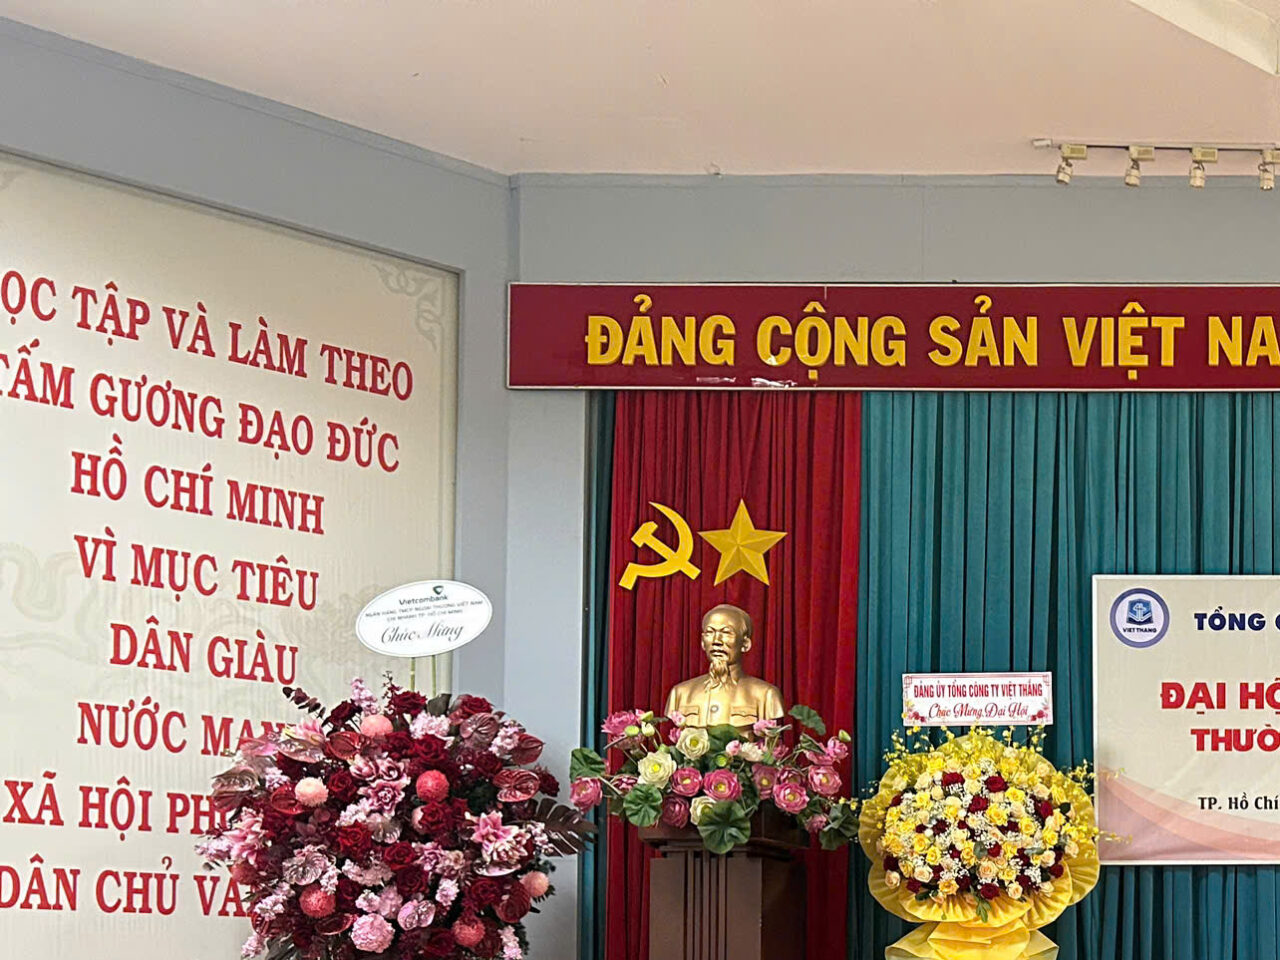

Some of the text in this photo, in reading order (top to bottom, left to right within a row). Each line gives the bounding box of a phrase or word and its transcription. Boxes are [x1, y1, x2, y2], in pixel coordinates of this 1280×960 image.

[72, 282, 150, 345] TẬP
[163, 302, 215, 357] VÀ
[228, 316, 307, 378] LÀM
[320, 344, 412, 400] THEO
[585, 295, 735, 365] ĐẢNG
[757, 303, 906, 379] CỘNG
[929, 295, 1037, 366] SẢN
[1063, 303, 1184, 379] VIỆT
[90, 374, 224, 440] GƯƠNG
[239, 403, 313, 459] ĐẠO
[327, 418, 398, 472] ĐỨC
[72, 434, 324, 534] HỒ CHÍ MINH
[74, 527, 318, 610] VÌ MỤC TIÊU
[399, 594, 448, 606] Vietcombank
[1193, 605, 1266, 631] TỔNG
[110, 616, 298, 685] DÂN GIÀU
[947, 679, 967, 698] TỔNG
[969, 681, 989, 698] CÔNG
[990, 684, 1000, 697] TY
[1001, 681, 1018, 700] VIỆT
[1019, 679, 1043, 697] THẮNG
[1160, 682, 1226, 714] ĐẠI
[78, 696, 186, 753] NƯỚC
[3, 771, 64, 825] XÃ
[79, 777, 152, 840] HỘI
[1198, 797, 1222, 810] TP.
[1228, 792, 1249, 810] Hồ
[1254, 795, 1279, 810] Chí
[96, 857, 179, 915] CHỦ
